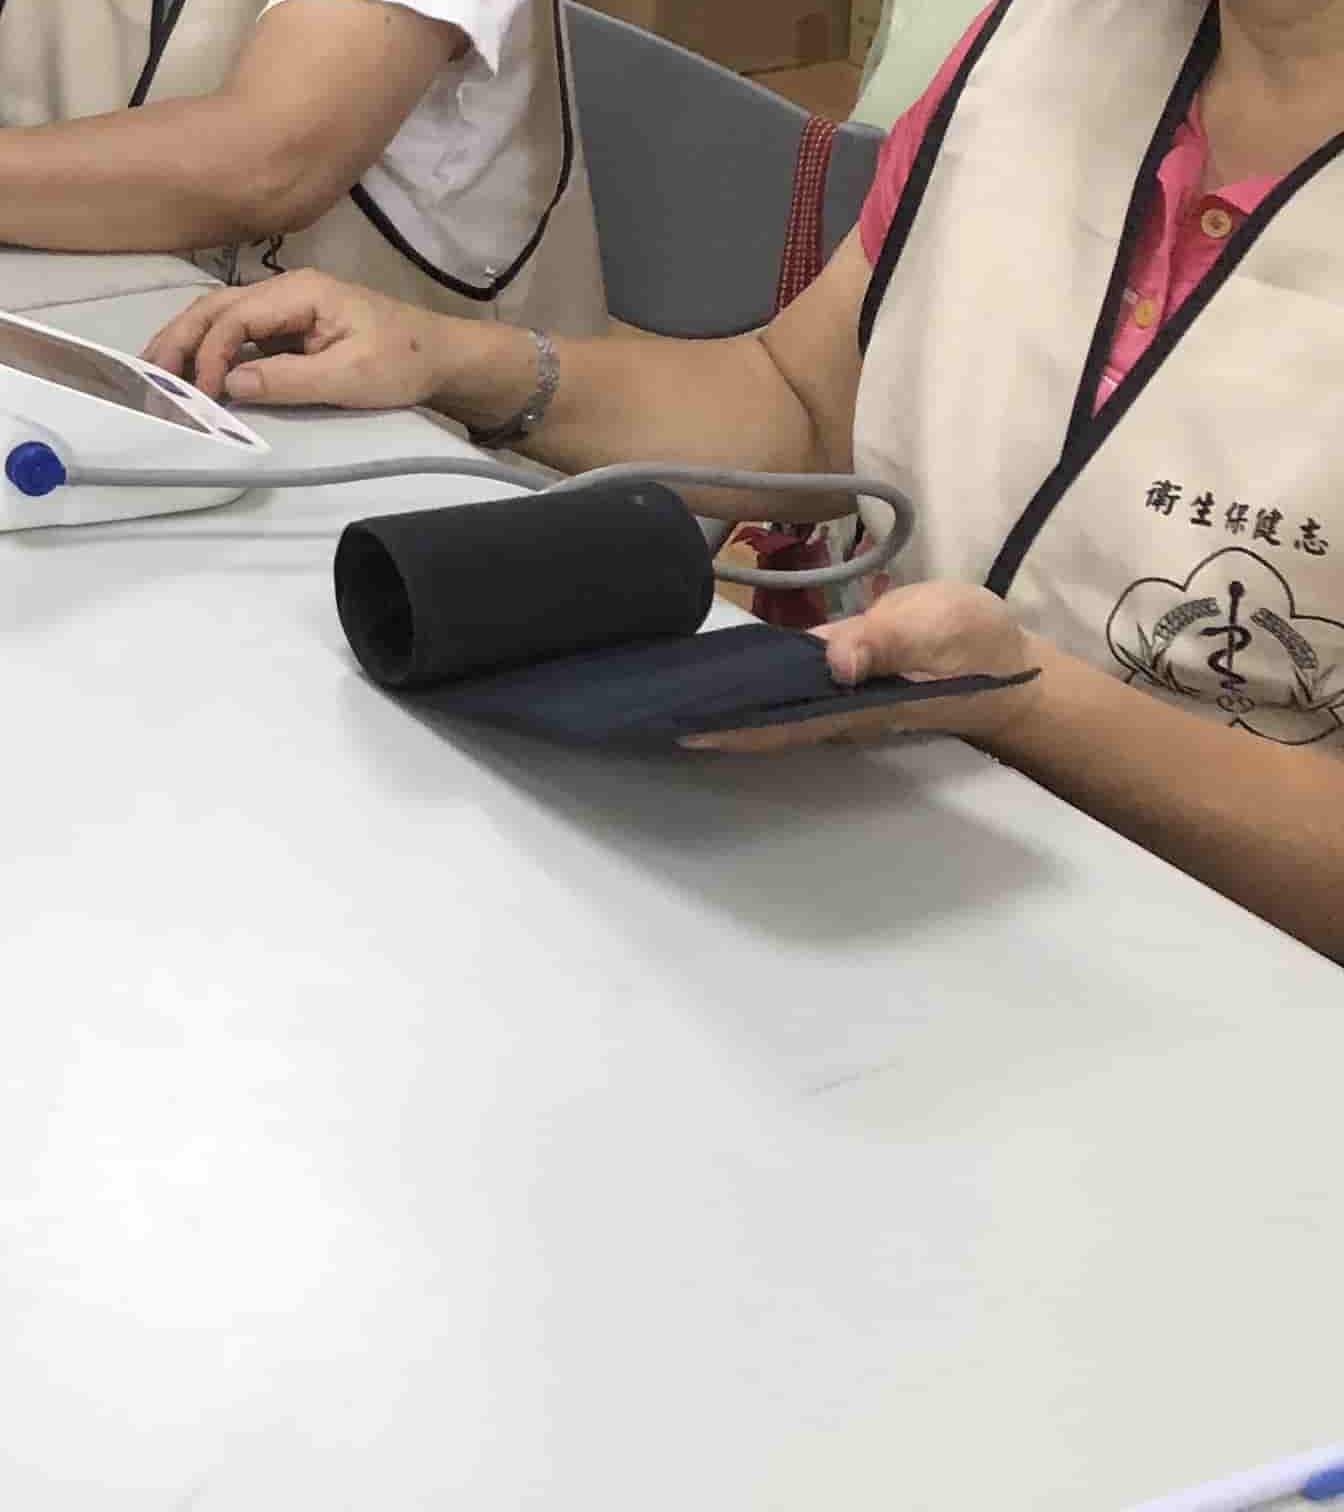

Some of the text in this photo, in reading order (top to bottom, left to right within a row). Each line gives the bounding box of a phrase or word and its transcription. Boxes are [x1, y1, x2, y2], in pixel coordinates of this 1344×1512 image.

[1144, 479, 1329, 557] 衛生保健志
